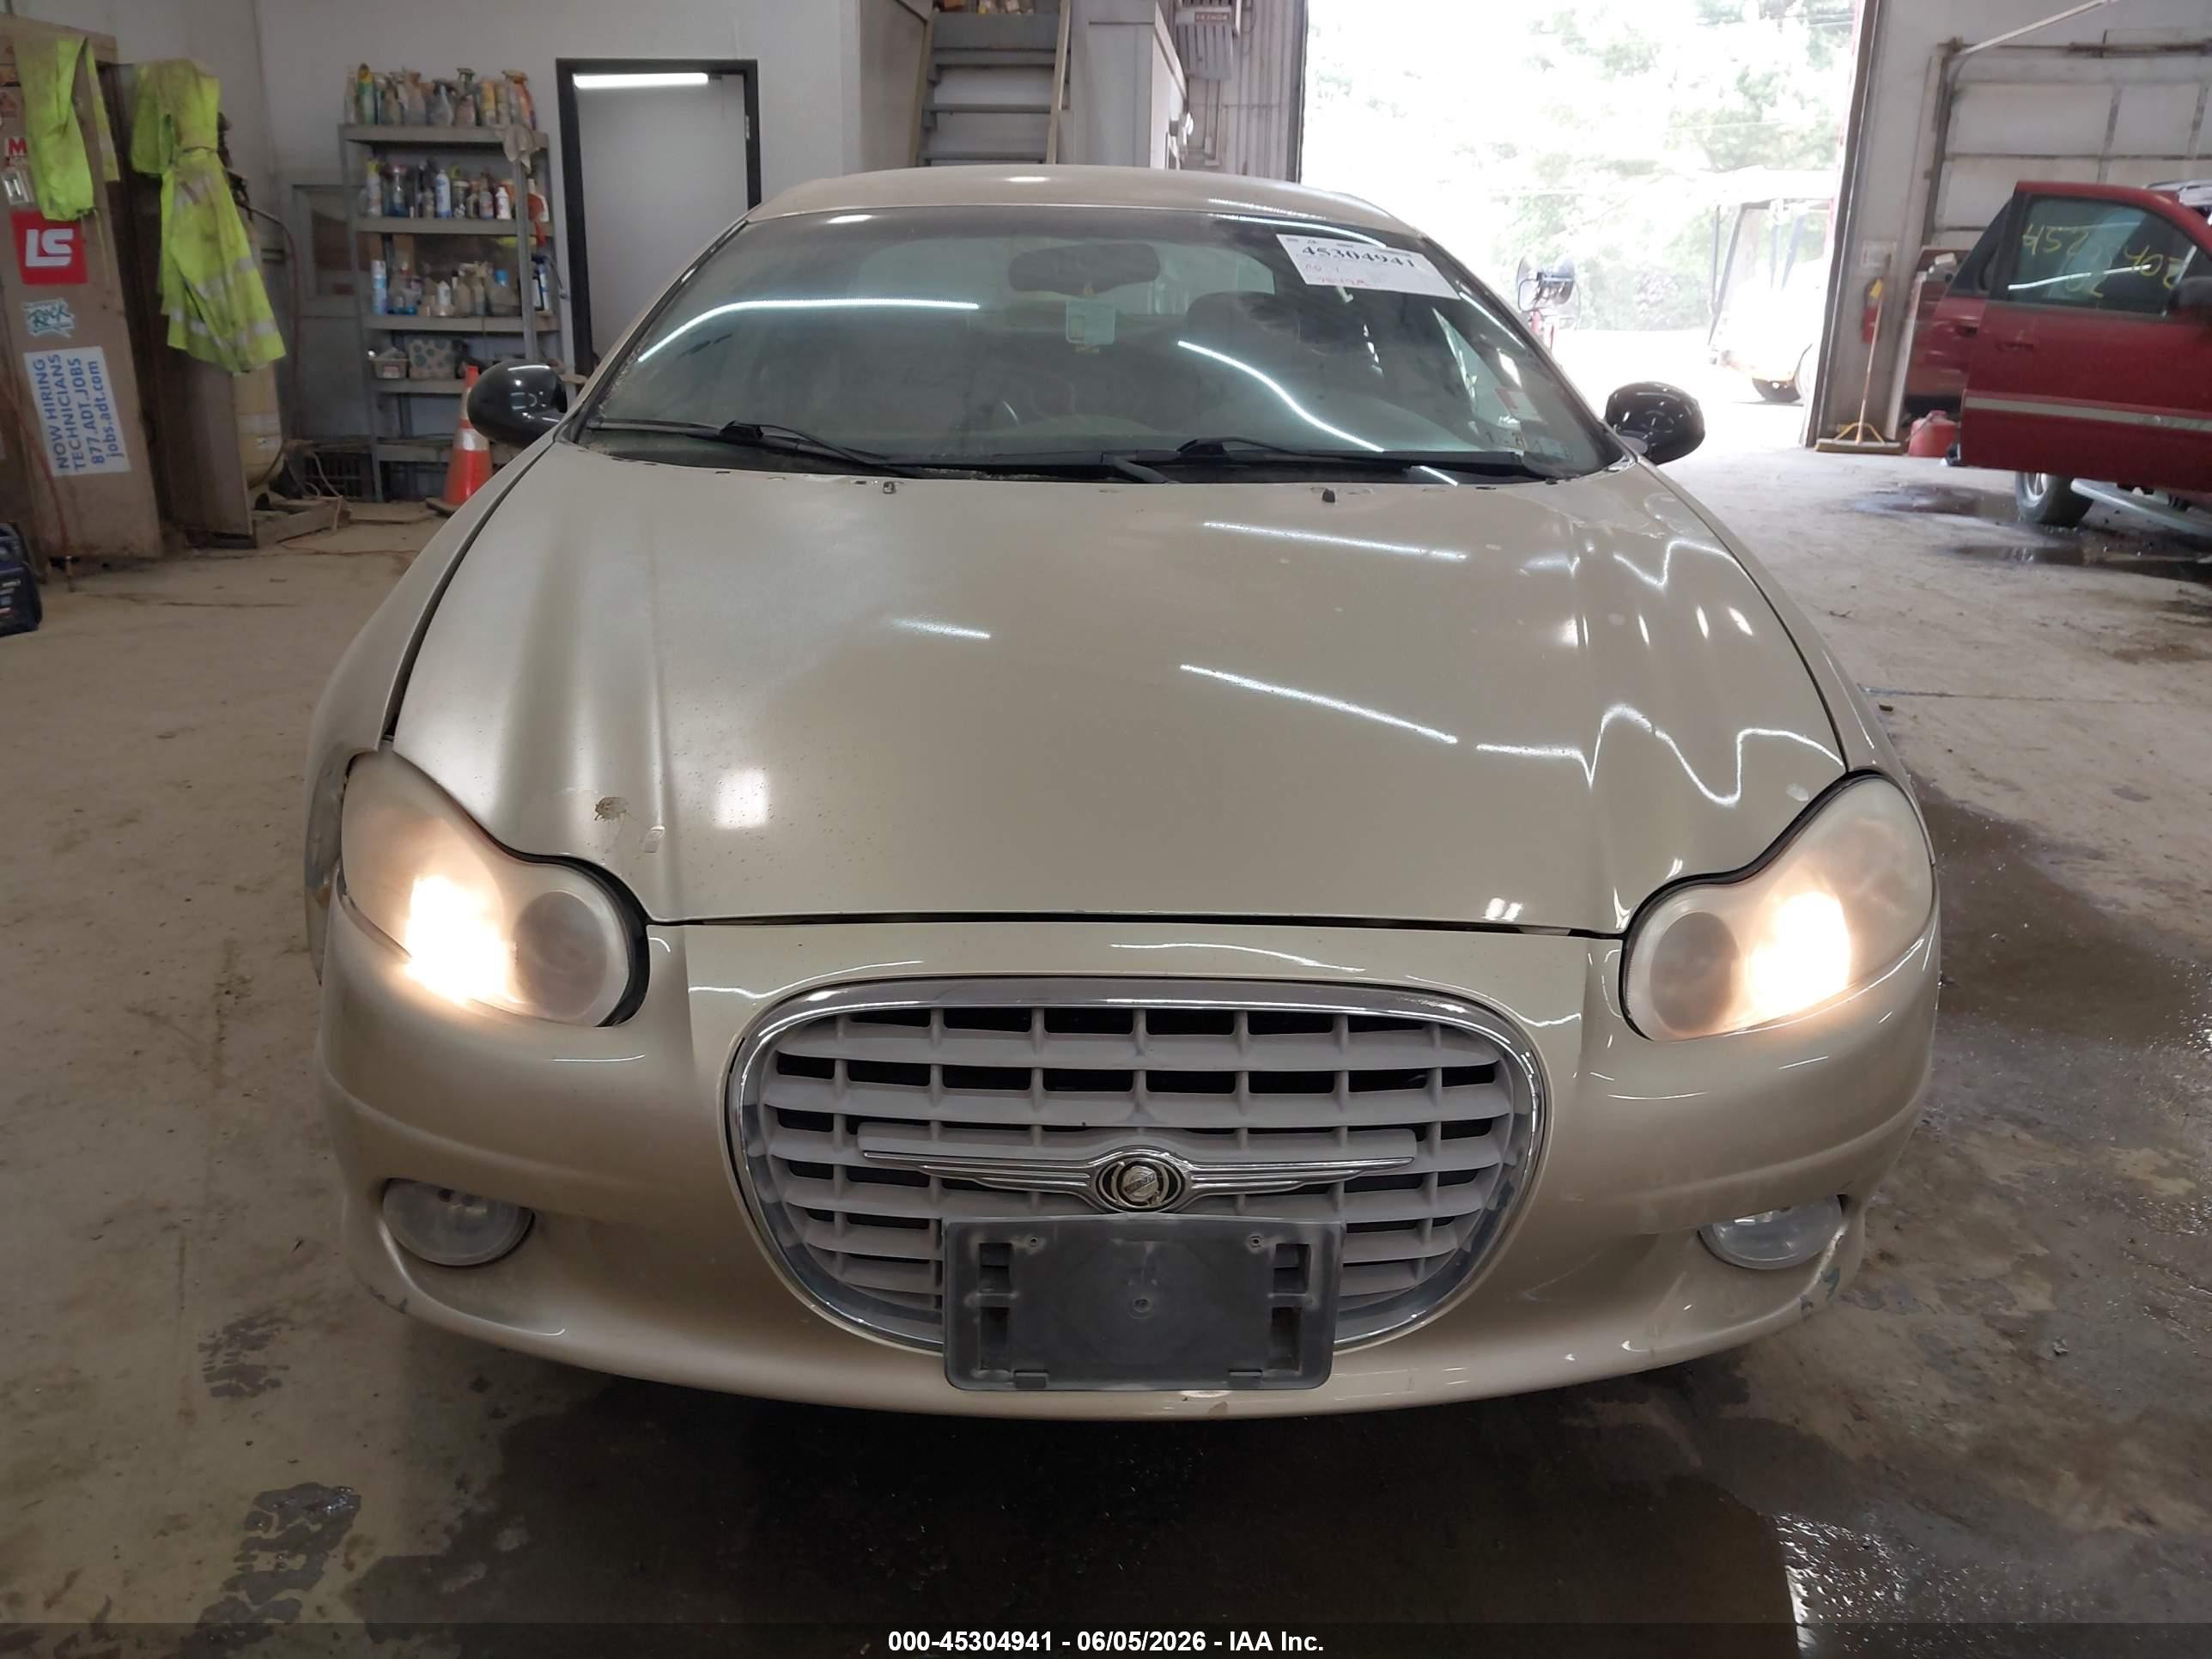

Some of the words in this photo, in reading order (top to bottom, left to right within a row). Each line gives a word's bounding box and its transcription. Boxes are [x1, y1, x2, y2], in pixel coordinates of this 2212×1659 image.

[25, 228, 74, 267] LS
[1302, 246, 1415, 267] 45304941
[33, 359, 58, 419] HIRING
[48, 354, 86, 471] TECHNICIANS
[88, 361, 124, 458] jobs.adt.com
[48, 425, 70, 469] NOW
